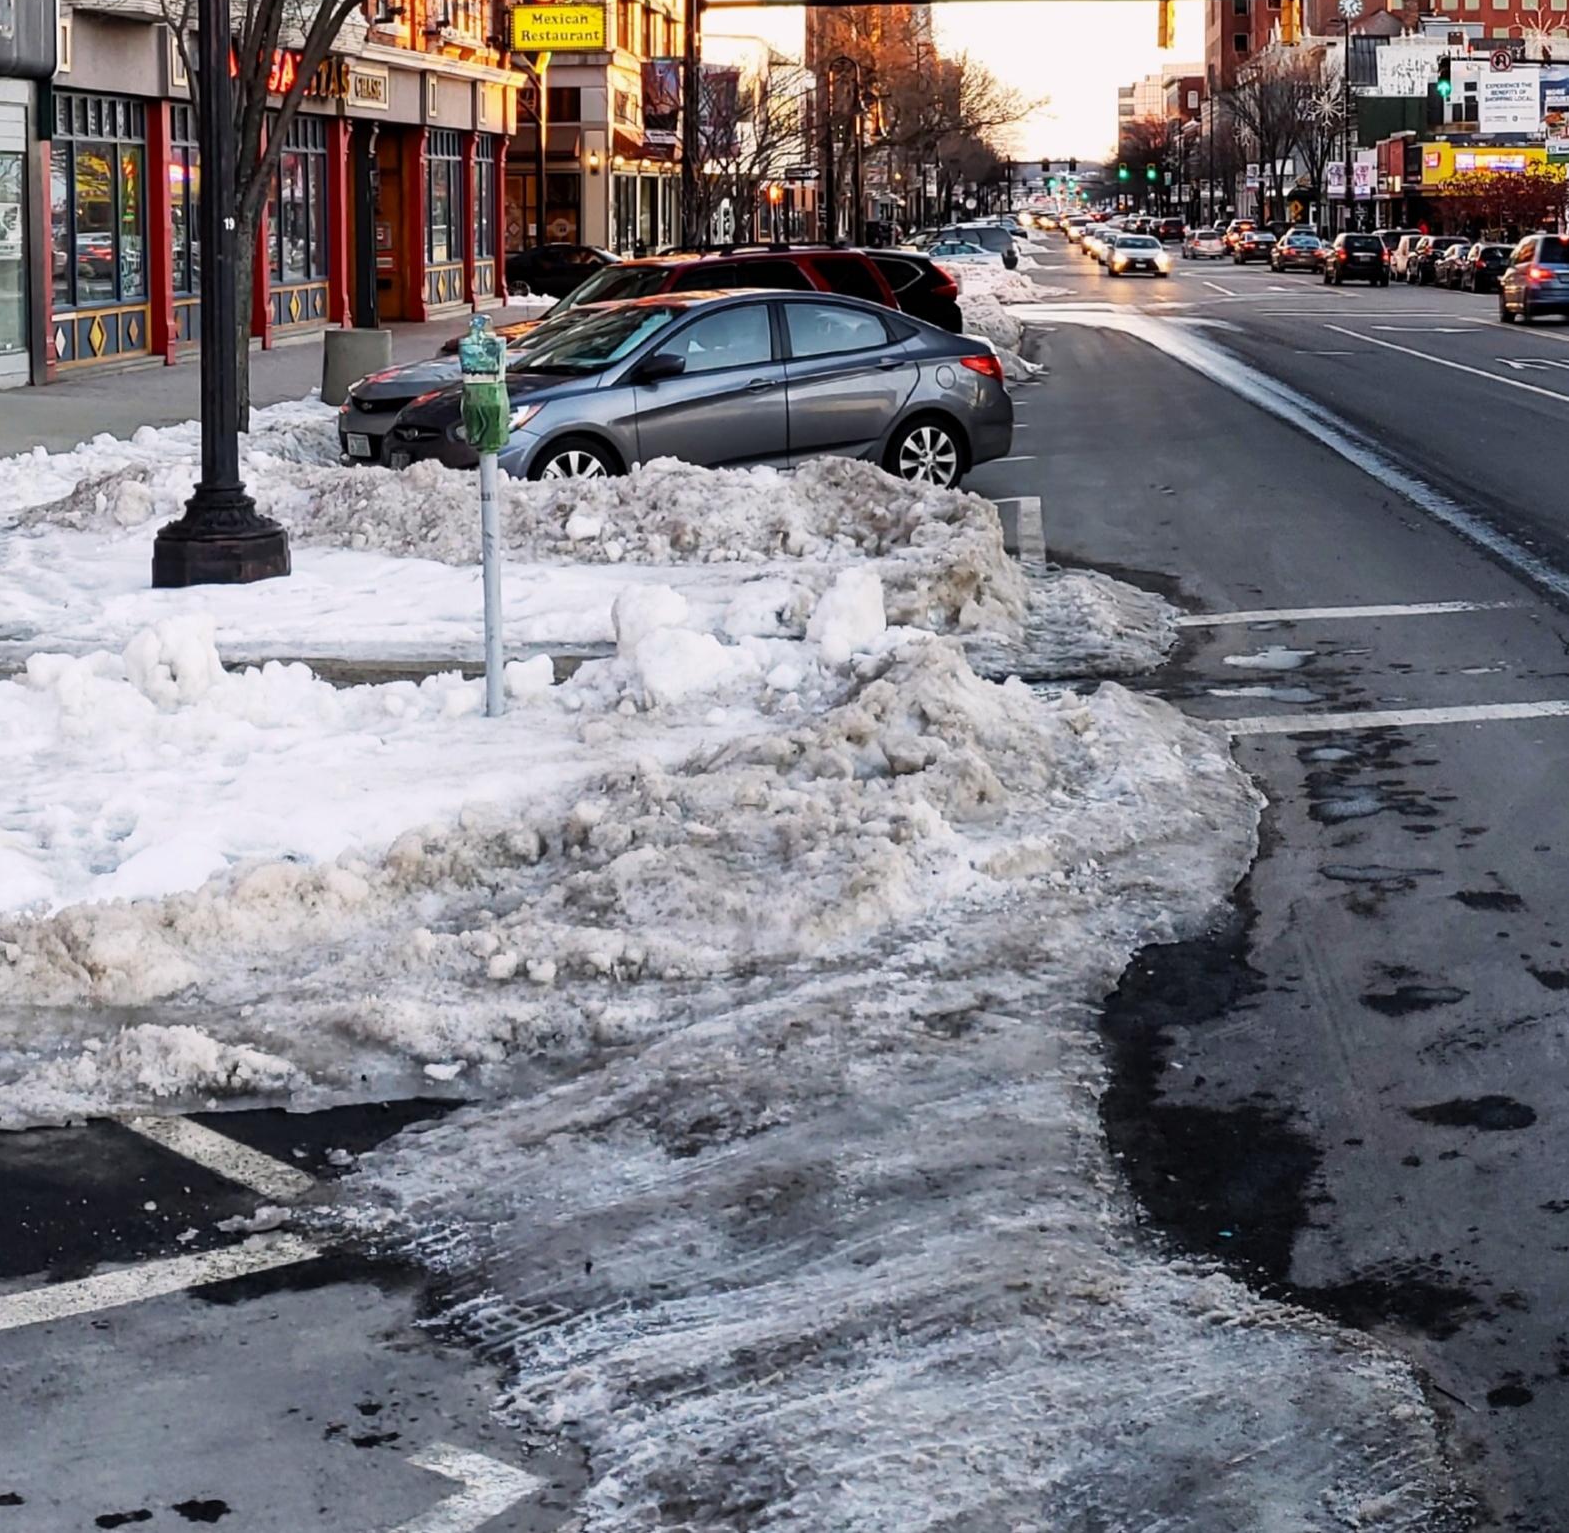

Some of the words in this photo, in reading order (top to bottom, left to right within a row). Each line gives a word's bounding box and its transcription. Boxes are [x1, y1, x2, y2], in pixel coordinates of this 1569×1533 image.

[531, 12, 589, 26] Mexican
[520, 29, 600, 43] Restaurant
[223, 217, 235, 230] 19
